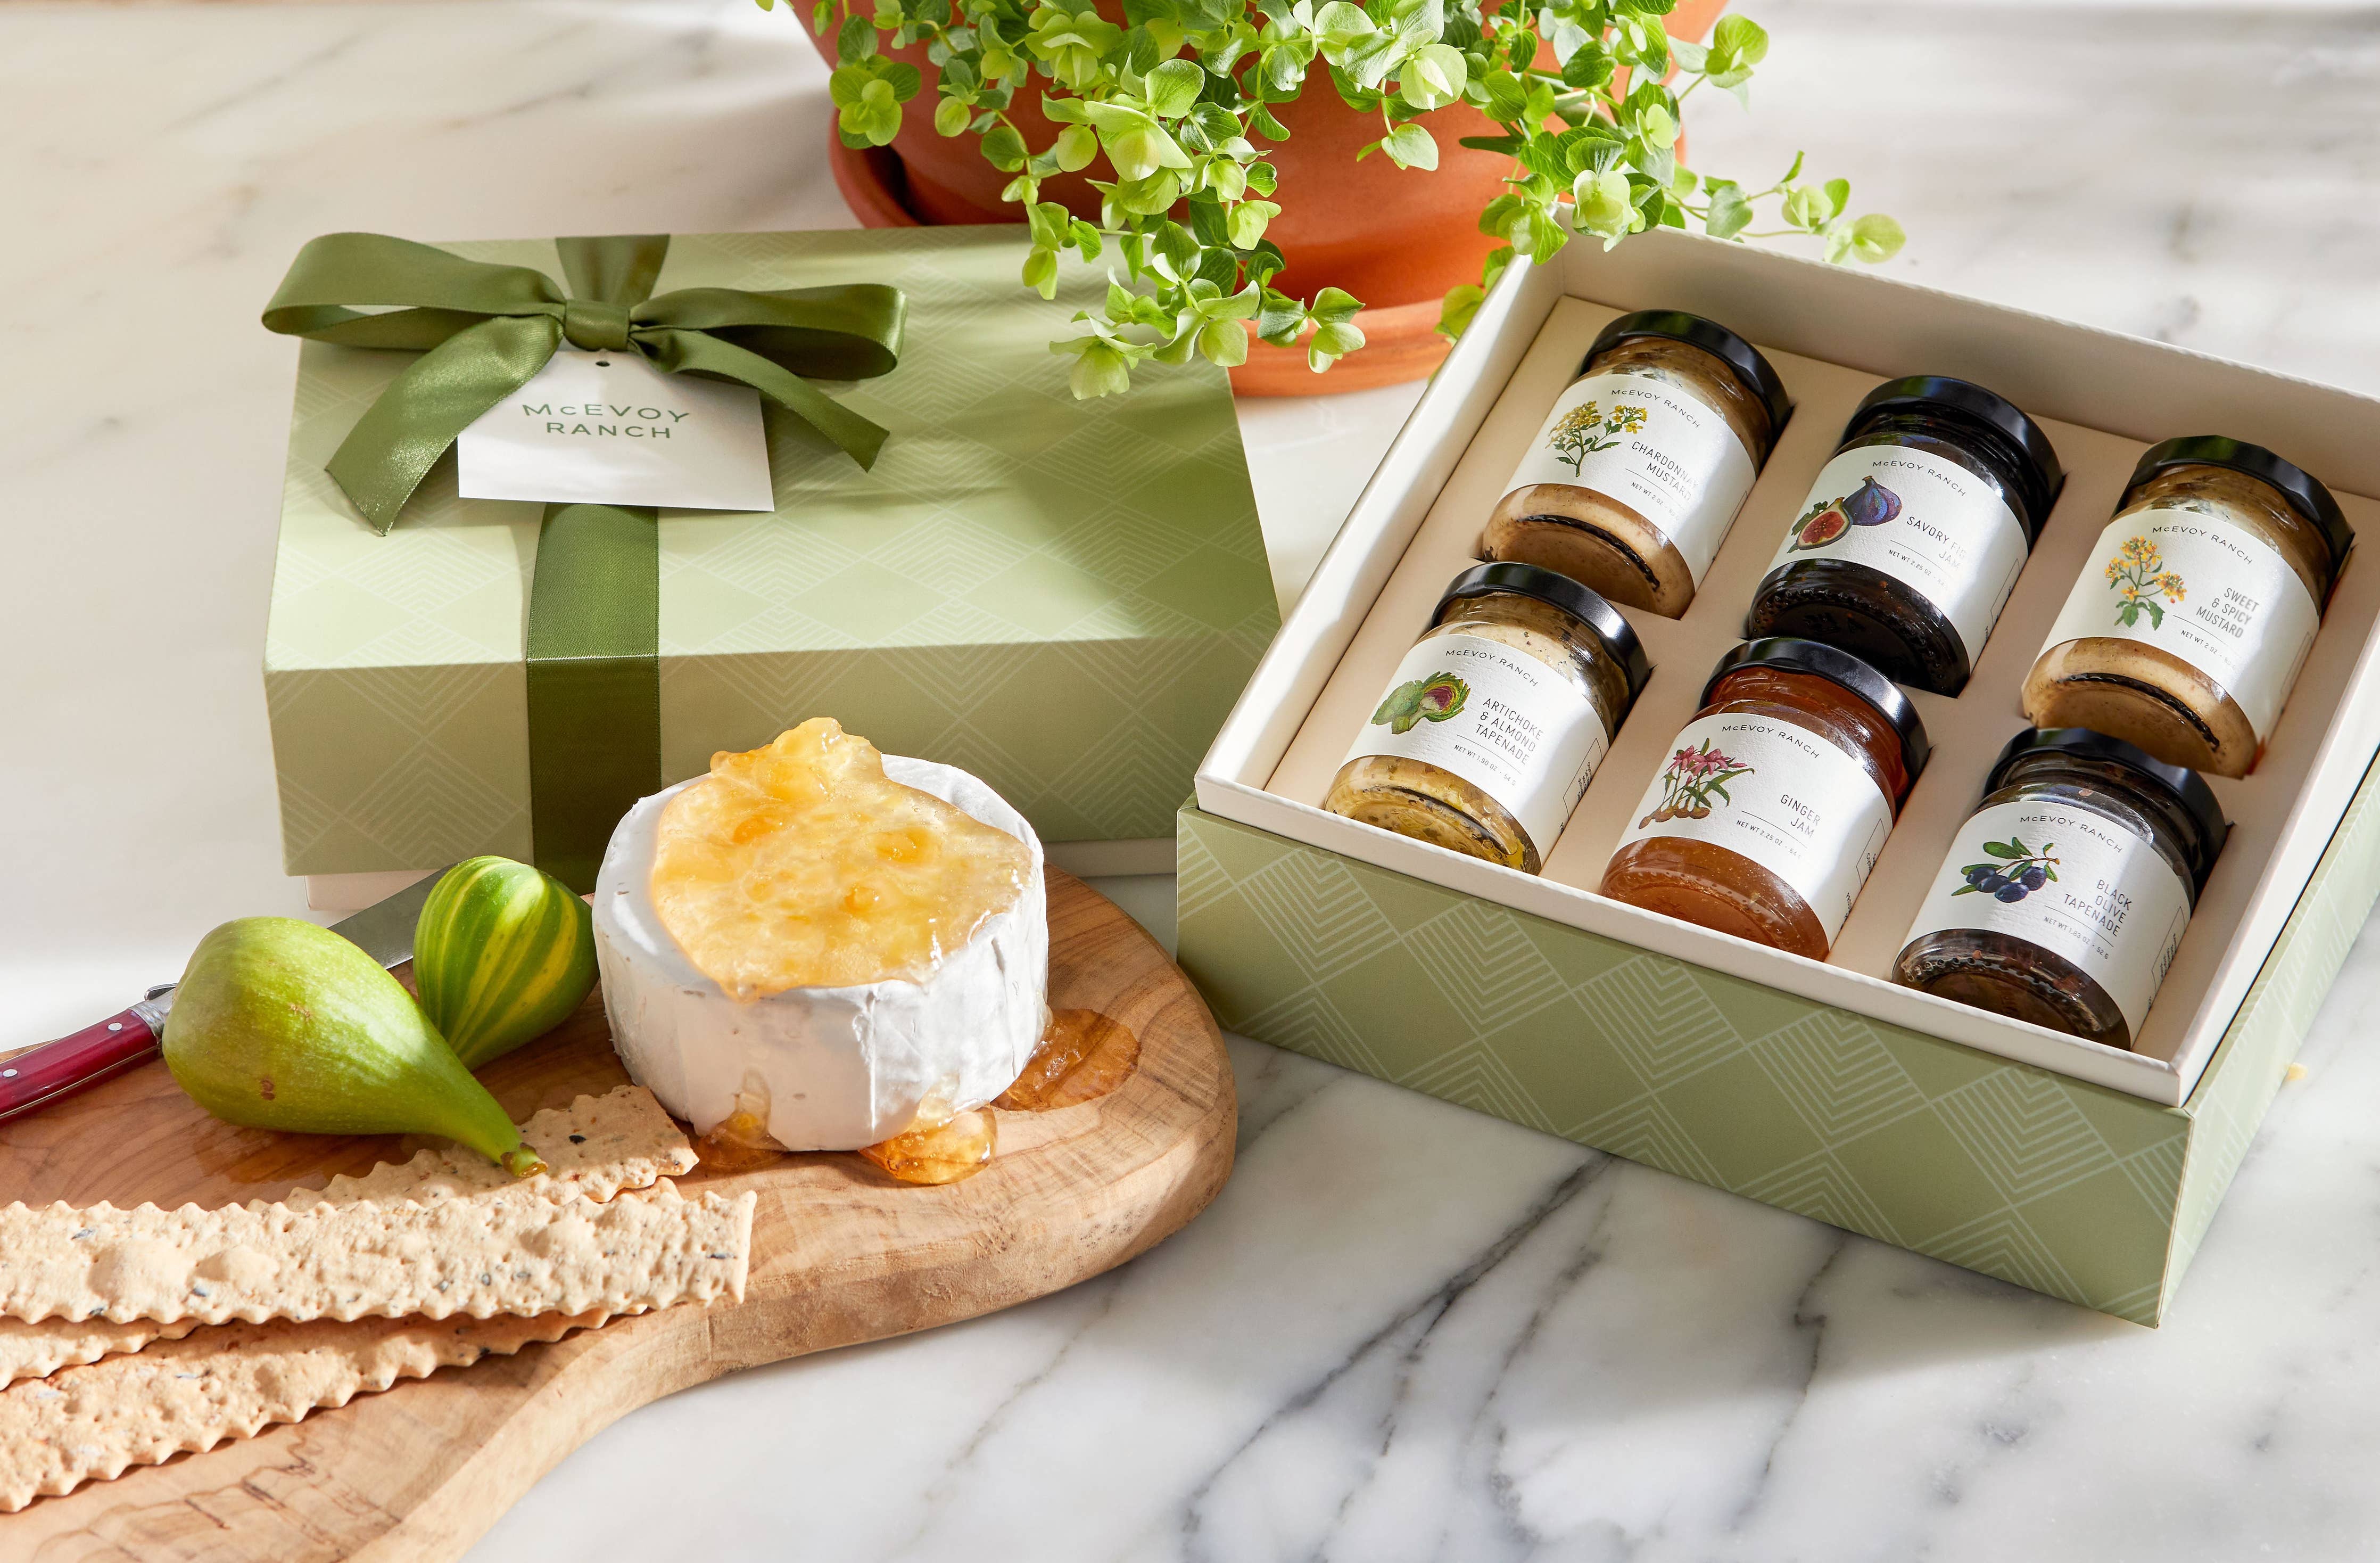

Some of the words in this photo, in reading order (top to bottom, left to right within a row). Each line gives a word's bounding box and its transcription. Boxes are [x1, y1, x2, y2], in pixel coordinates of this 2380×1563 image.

[522, 404, 690, 423] McEVOY
[1612, 390, 1661, 401] McEVOY
[1664, 399, 1700, 429] RANCH
[546, 422, 671, 439] RANCH
[1631, 482, 1643, 491] NET
[1647, 462, 1691, 501] MUSTARD
[1872, 460, 1924, 472] McEVOY
[1927, 468, 1966, 496] RANCH
[1907, 516, 1950, 544] SAVORY
[2152, 525, 2207, 537] McEVOY
[2211, 534, 2253, 565] RANCH
[1888, 549, 1900, 558] NET
[1911, 560, 1923, 571] 2.25
[2211, 598, 2220, 608] &
[2222, 604, 2252, 625] SPICY
[2224, 588, 2259, 612] SWEET
[2180, 630, 2193, 639] NET
[2194, 636, 2204, 645] WT
[2196, 606, 2244, 638] MUSTARD
[1445, 649, 1496, 661] McEVOY
[1499, 658, 1538, 687] RANCH
[1480, 711, 1489, 721] &
[1491, 718, 1536, 752] ALMOND
[1483, 698, 1544, 741] ARTICHOKE
[1454, 745, 1466, 753] NET
[1477, 755, 1489, 766] 1.90
[1476, 723, 1530, 765] TAPENADE
[1722, 724, 1775, 734] McEVOY
[1778, 731, 1820, 759] RANCH
[1780, 794, 1821, 826] GINGER
[1736, 820, 1749, 828] NET
[1760, 830, 1774, 841] 2.25
[1774, 838, 1783, 846] OZ
[1791, 818, 1815, 839] JAM
[2020, 815, 2076, 826] McEVOY
[2080, 824, 2123, 853] RANCH
[2095, 895, 2127, 924] OLIVE
[2096, 879, 2133, 911] BLACK
[2064, 893, 2120, 937] TAPENADE
[2044, 915, 2057, 925] NET
[2058, 922, 2069, 931] WT
[2069, 927, 2081, 939] 1.83
[2082, 936, 2091, 945] OZ
[2096, 946, 2104, 956] 52
